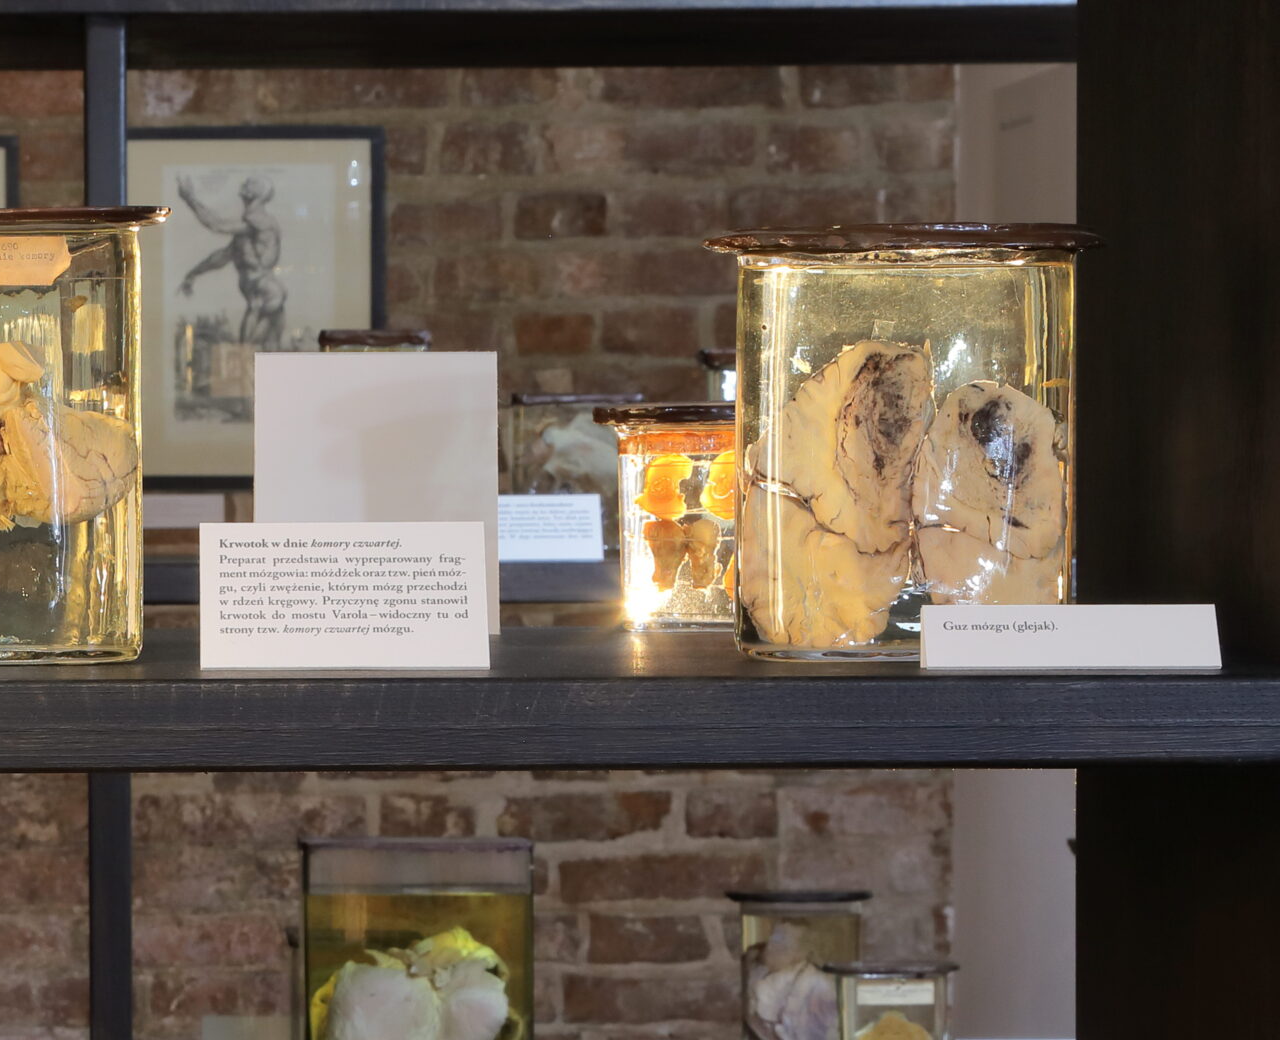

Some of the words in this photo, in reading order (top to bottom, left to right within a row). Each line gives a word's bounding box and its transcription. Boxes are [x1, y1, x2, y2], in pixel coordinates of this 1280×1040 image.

[219, 538, 269, 548] Krwotok
[283, 538, 308, 548] dnie
[310, 538, 351, 551] komory
[352, 538, 402, 550] czwartej.
[219, 554, 266, 567] Preparat
[272, 554, 339, 567] przedstawia
[345, 556, 433, 567] wypreparowany
[439, 553, 466, 566] frag-
[249, 568, 309, 581] mózgowia:
[310, 567, 362, 578] móżdżek
[388, 569, 411, 577] tzw.
[412, 568, 436, 580] pień
[438, 568, 467, 577] móz-
[240, 582, 266, 595] czyli
[269, 582, 324, 594] zwężenie,
[328, 581, 369, 594] którym
[372, 582, 403, 594] mózg
[406, 581, 468, 594] przechodzi
[232, 596, 264, 606] rdzeń
[267, 596, 318, 609] kręgowy.
[322, 595, 380, 608] Przyczynę
[383, 598, 417, 608] zgonu
[420, 595, 468, 605] stanowił
[219, 610, 267, 620] krwotok
[291, 612, 326, 620] mostu
[219, 627, 255, 637] strony
[257, 623, 280, 634] tzw.
[282, 624, 322, 637] komory
[324, 624, 371, 636] czwartej
[372, 623, 414, 636] mózgu.
[943, 621, 968, 631] Guz
[971, 621, 1010, 634] mózgu
[1012, 620, 1058, 634] (glejak).
